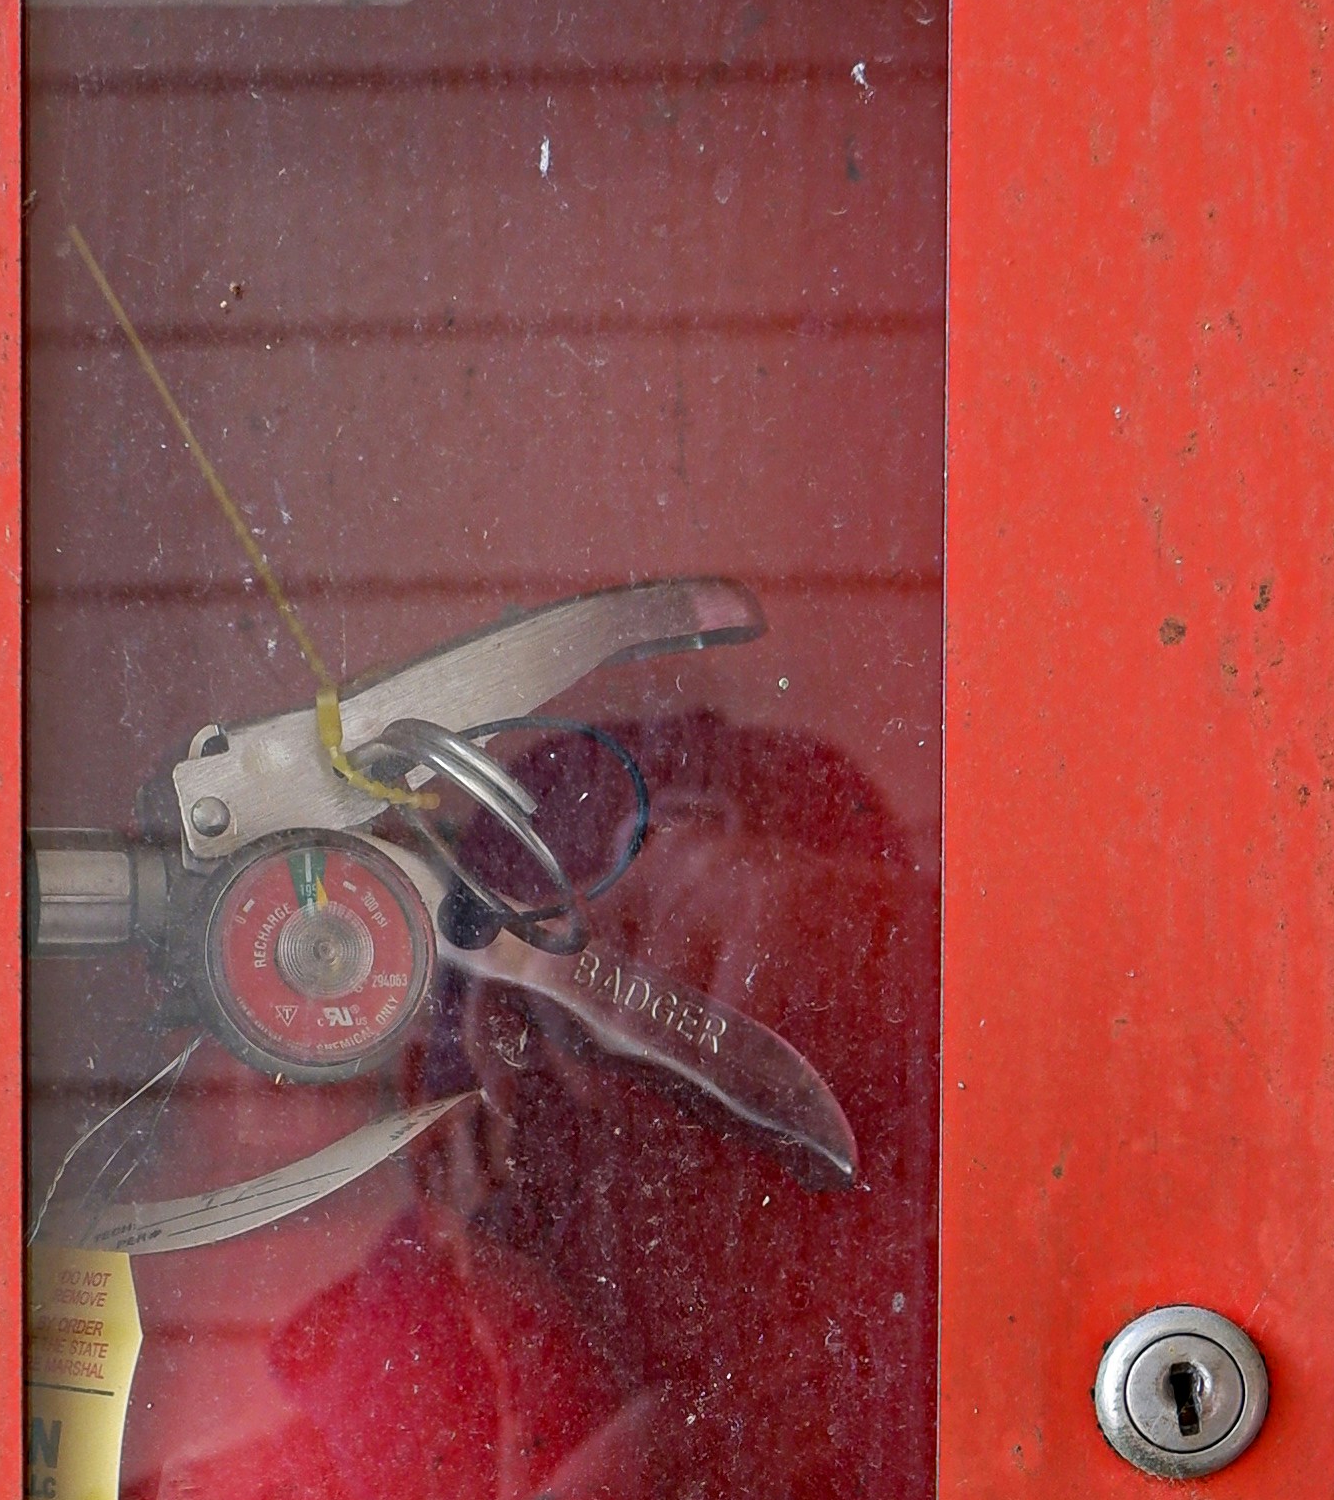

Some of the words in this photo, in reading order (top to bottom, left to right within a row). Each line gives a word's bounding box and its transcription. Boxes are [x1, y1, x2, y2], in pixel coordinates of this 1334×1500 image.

[254, 902, 294, 969] RECHARGE
[376, 994, 400, 1025] ONLY
[572, 952, 729, 1054] BADGER
[82, 1271, 112, 1288] NOT
[54, 1288, 107, 1307] REMOVE
[58, 1317, 104, 1337] ORDER
[69, 1340, 109, 1359] STATE
[44, 1358, 104, 1380] MARSHAL
